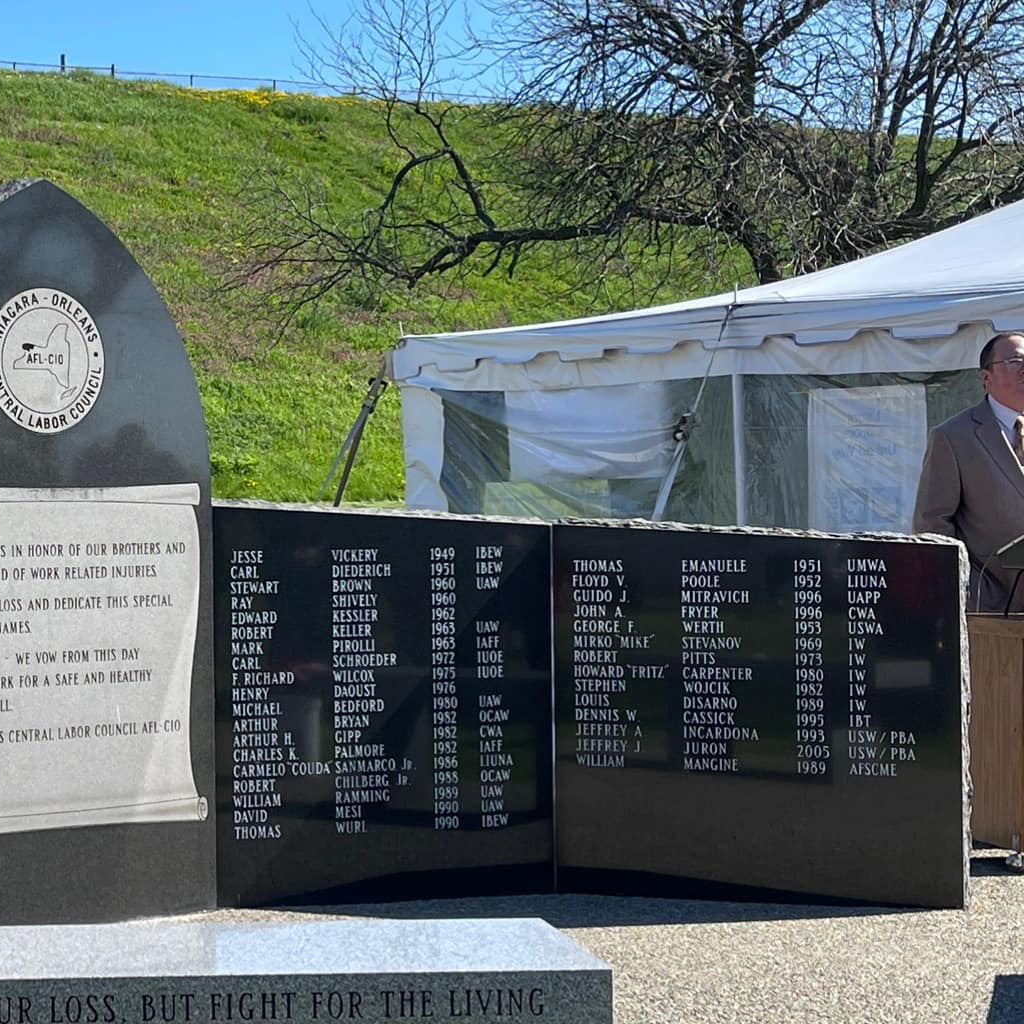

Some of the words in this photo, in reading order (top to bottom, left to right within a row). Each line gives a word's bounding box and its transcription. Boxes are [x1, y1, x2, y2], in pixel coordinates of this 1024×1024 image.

[52, 294, 97, 343] ORLEANS
[27, 354, 63, 364] AFL-CIO
[28, 415, 68, 429] LABOR
[69, 367, 101, 419] COUNCIL
[12, 545, 23, 557] IN
[28, 545, 63, 557] HONOR
[69, 544, 80, 556] OF
[86, 544, 107, 556] OUR
[113, 543, 160, 555] BROTHERS
[166, 542, 185, 554] AND
[231, 551, 263, 564] JESSE
[332, 549, 378, 562] VICKERY
[430, 548, 455, 560] 1949
[476, 546, 503, 559] IBEW
[13, 568, 25, 580] OF
[31, 568, 59, 580] WORK
[65, 567, 107, 579] RELATED
[231, 566, 259, 579] CARL
[332, 564, 391, 578] DIEDERICH
[431, 563, 454, 575] 1951
[476, 562, 503, 574] IBEW
[574, 560, 623, 573] THOMAS
[682, 560, 746, 573] EMANUELE
[794, 560, 821, 572] 1951
[848, 559, 886, 572] UMWA
[231, 581, 279, 595] STEWART
[332, 579, 372, 592] BROWN
[431, 578, 455, 590] 1960
[476, 577, 499, 589] UAW
[573, 575, 609, 588] FLOYD
[682, 575, 720, 588] POOLE
[794, 575, 821, 588] 1952
[848, 575, 887, 588] LIUNA
[29, 599, 49, 611] AND
[54, 597, 102, 610] DEDICATE
[107, 596, 128, 609] THIS
[134, 595, 173, 607] SPECIAL
[231, 597, 253, 610] RAY
[332, 594, 378, 607] SHIVELY
[432, 593, 456, 605] 1960
[574, 590, 612, 603] GUIDO
[681, 591, 749, 604] MITRAVICH
[794, 591, 821, 604] 1996
[848, 591, 881, 604] UAPP
[574, 606, 607, 618] JOHN
[681, 606, 718, 619] FRYER
[795, 606, 822, 620] 1996
[848, 607, 875, 620] CWA
[16, 654, 30, 665] WE
[36, 653, 56, 664] VOW
[62, 651, 89, 663] FROM
[94, 650, 116, 662] THIS
[122, 649, 140, 661] DAY
[20, 676, 39, 688] FOR
[44, 675, 50, 687] A
[56, 673, 79, 686] SAFE
[84, 672, 104, 684] AND
[110, 670, 152, 683] HEALTHY
[9, 729, 54, 743] CENTRAL
[58, 726, 90, 739] LABOR
[95, 724, 138, 737] COUNCIL
[142, 721, 181, 733] AFL-CIO
[142, 994, 194, 1022] BUT
[210, 992, 295, 1020] FIGHT
[312, 992, 362, 1019] FOR
[379, 990, 433, 1018] THE
[450, 988, 544, 1017] LIVING
